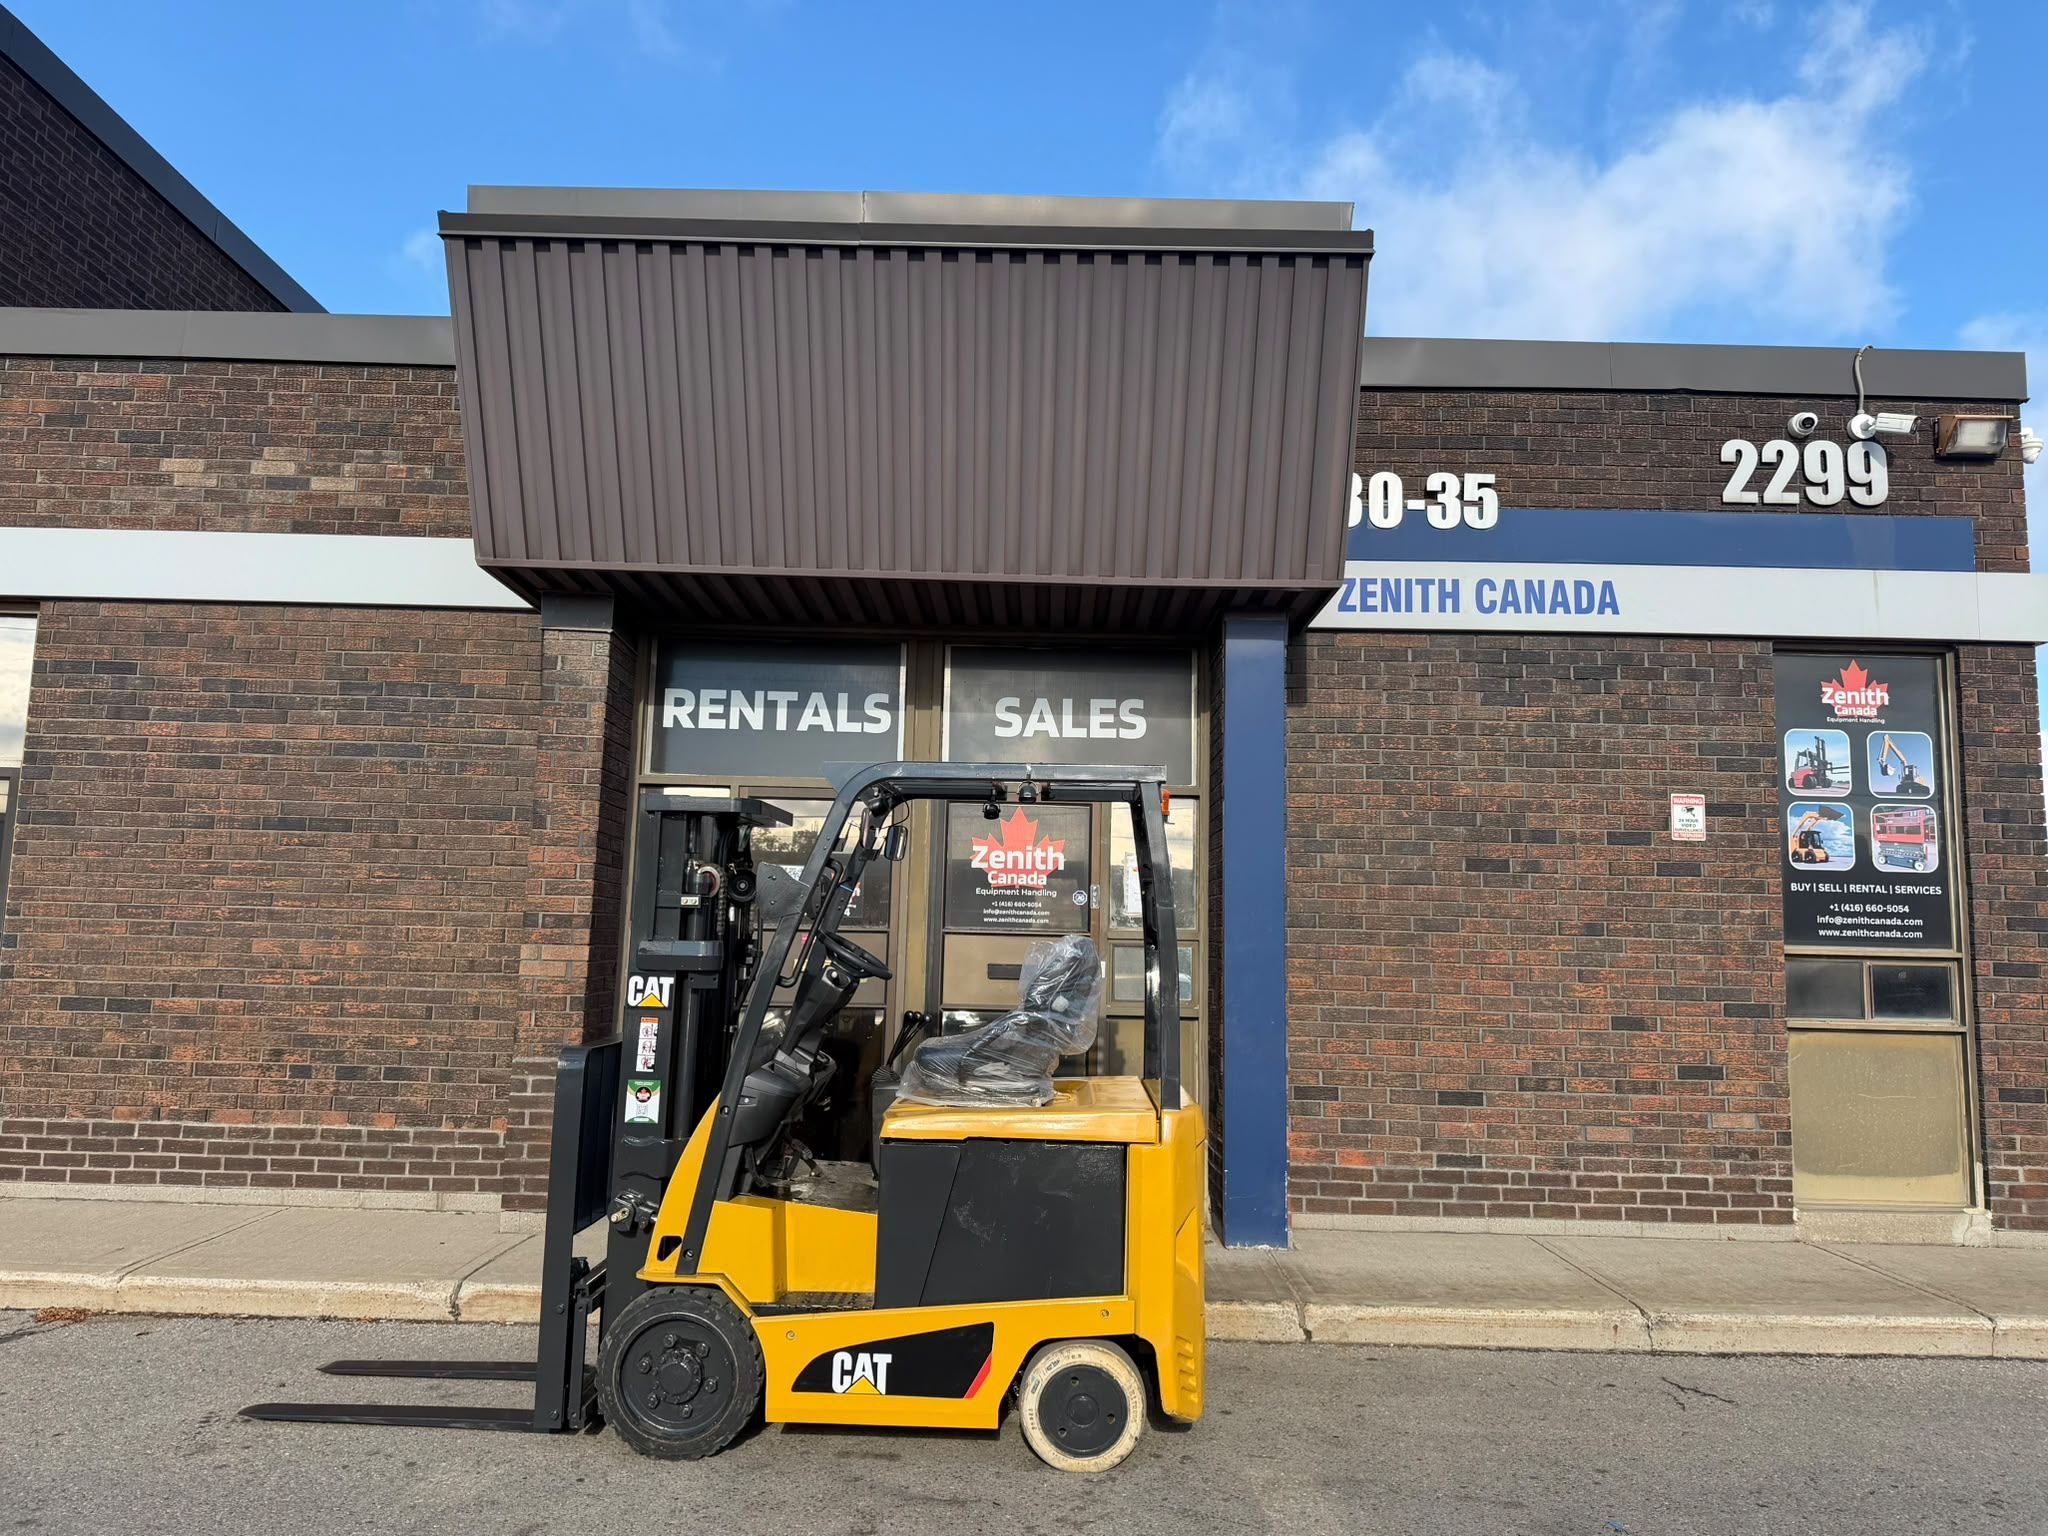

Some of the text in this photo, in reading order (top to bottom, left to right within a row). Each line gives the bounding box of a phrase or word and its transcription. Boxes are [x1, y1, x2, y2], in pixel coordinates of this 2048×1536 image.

[1720, 439, 1889, 506] 2299
[1337, 577, 1620, 615] ZENITH CANADA
[1821, 687, 1889, 705] Zenith
[661, 687, 892, 734] RENTALS
[993, 696, 1147, 740] SALES
[1834, 705, 1878, 716] Canada
[971, 845, 1065, 871] Zenith
[987, 870, 1047, 885] Canada
[975, 888, 1057, 898] Equipment Handling
[1790, 882, 1811, 892] BUY
[1818, 883, 1842, 893] SELL
[1849, 884, 1887, 894] RENTAL
[1894, 885, 1942, 895] SERVICES
[1841, 903, 1863, 912] (416)
[1865, 904, 1910, 913] 660-5054
[1816, 915, 1923, 926] info@zenithcanada.com
[1818, 929, 1923, 938] www.zenithcanada.com
[627, 975, 675, 1008] CAT
[831, 1351, 893, 1396] CAT
